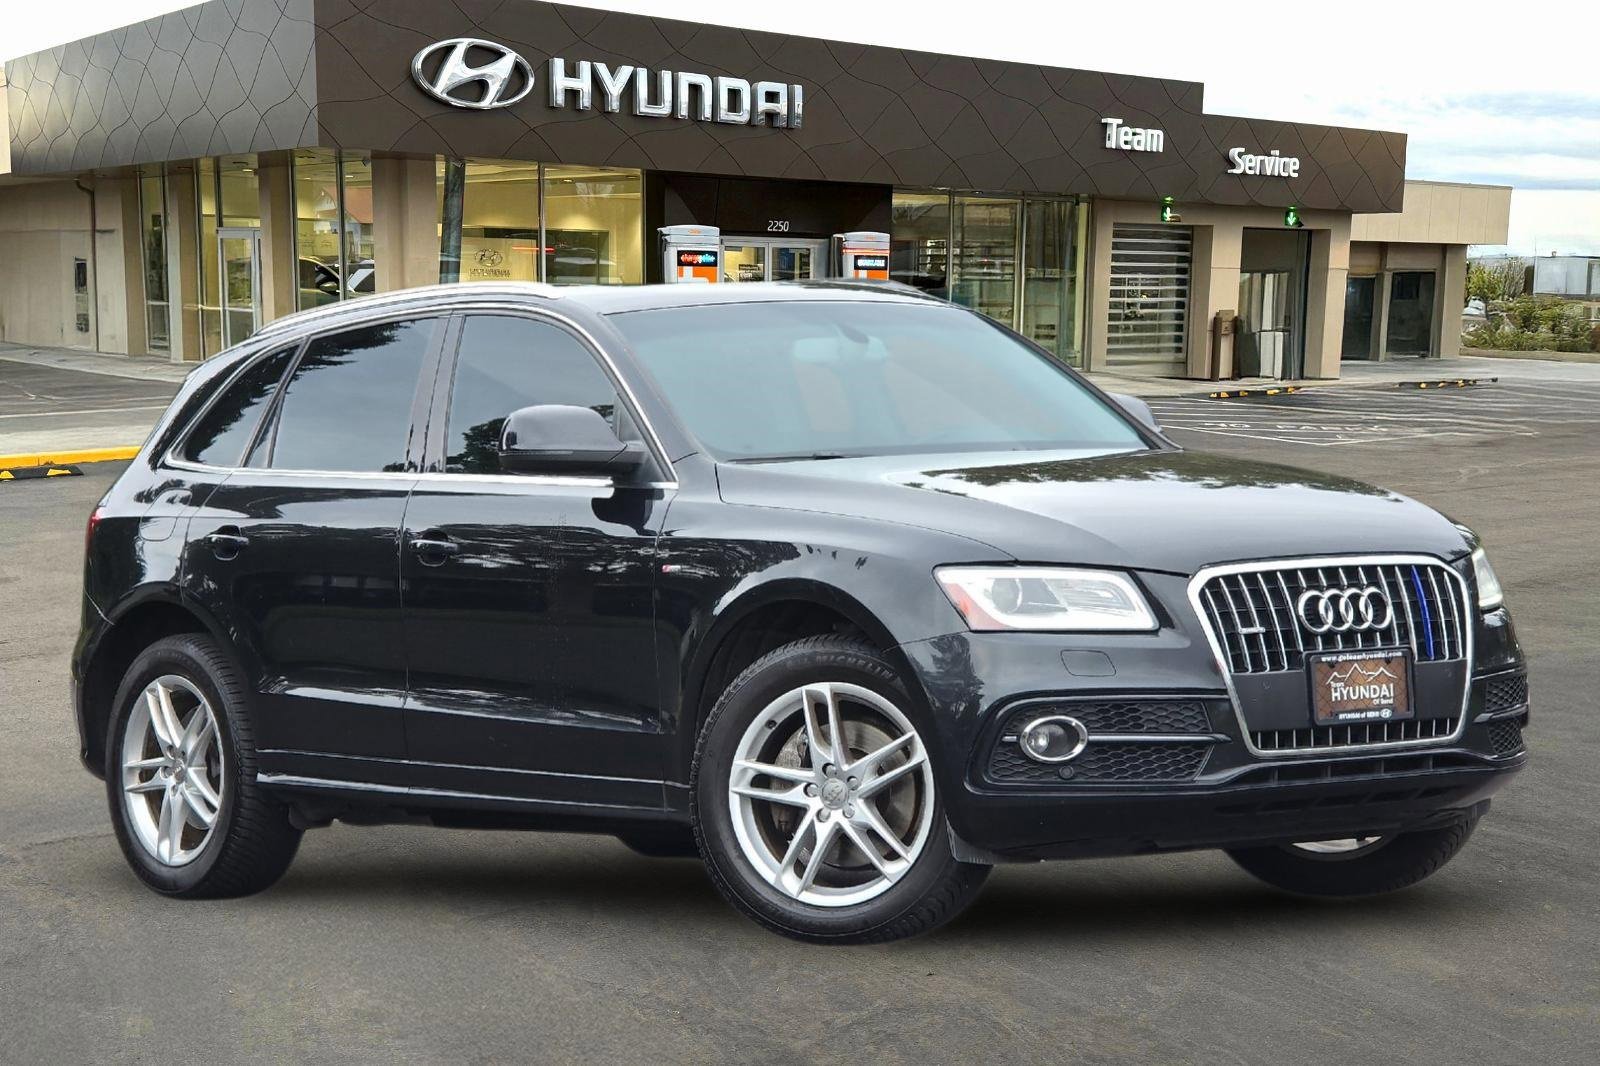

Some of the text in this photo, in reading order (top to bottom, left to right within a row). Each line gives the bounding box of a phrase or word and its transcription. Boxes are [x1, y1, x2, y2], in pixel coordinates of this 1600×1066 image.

[549, 57, 803, 129] HYUNDAI
[1101, 117, 1164, 152] Team
[1227, 147, 1300, 178] Service
[767, 220, 790, 232] 2250
[1331, 683, 1394, 702] HYUNDAI
